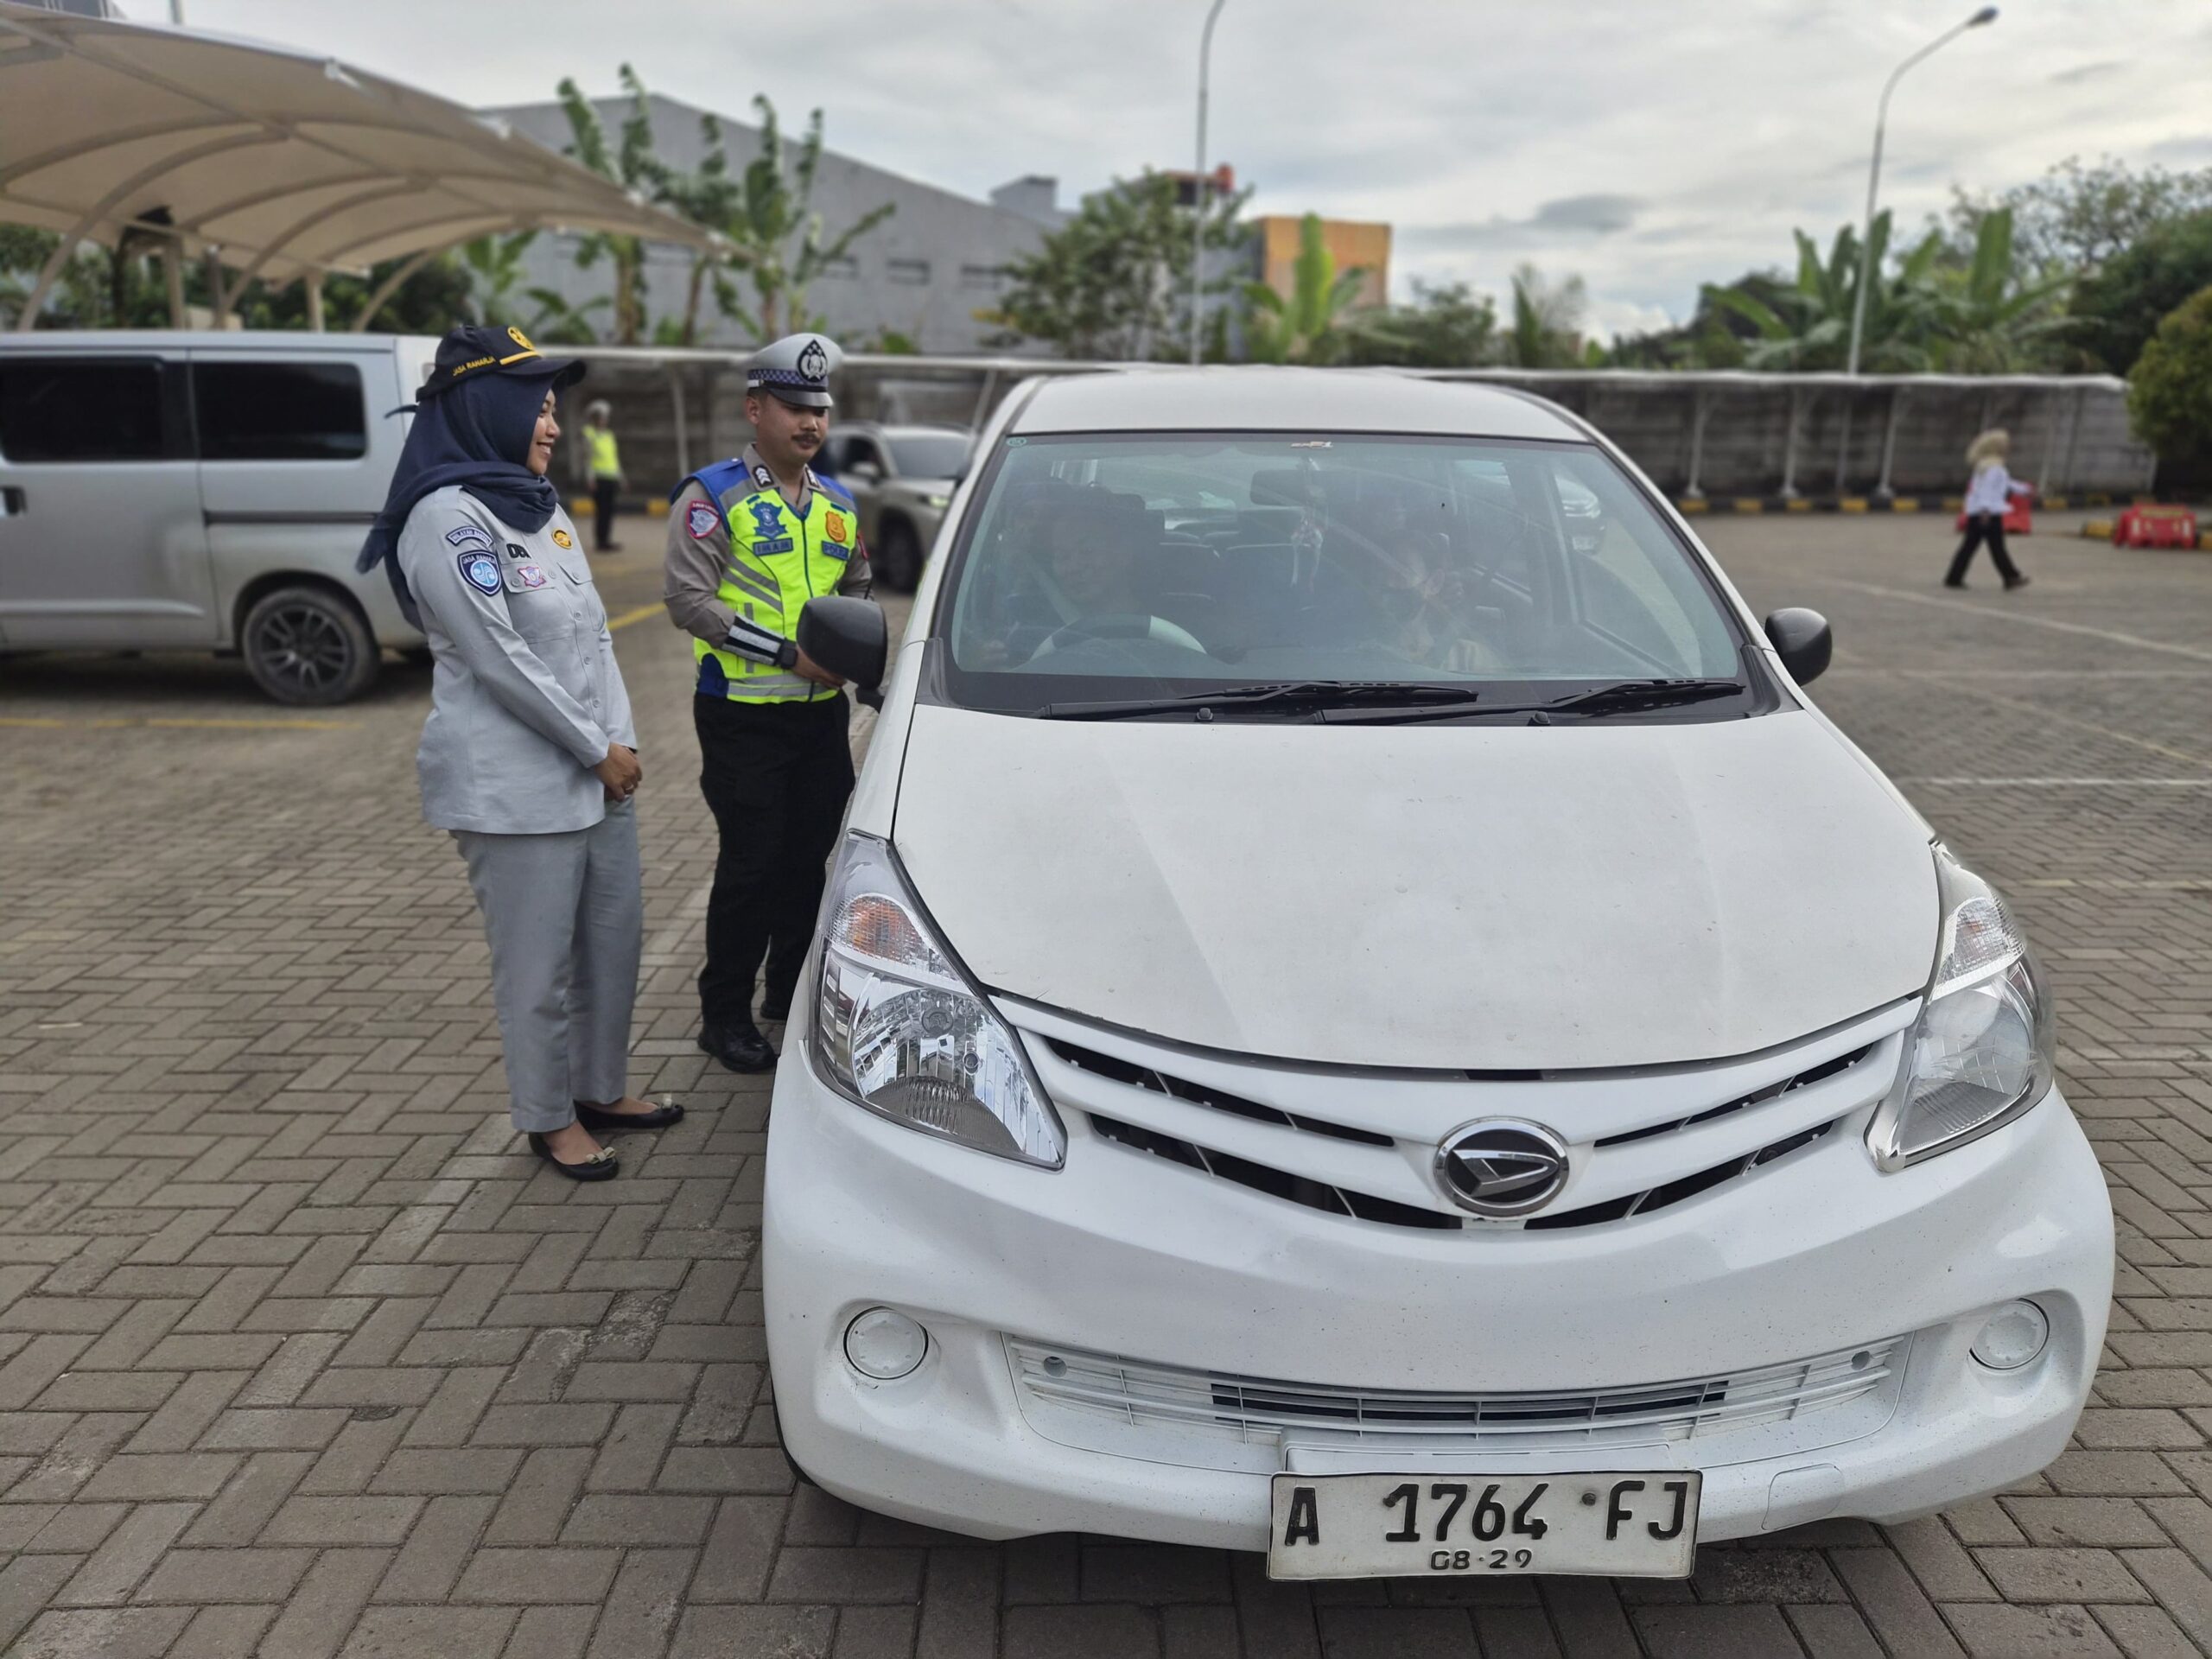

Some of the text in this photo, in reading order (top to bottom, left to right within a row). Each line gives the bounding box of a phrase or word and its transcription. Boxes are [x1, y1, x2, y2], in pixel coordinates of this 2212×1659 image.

[1284, 1480, 1688, 1546] A 1764 FJ
